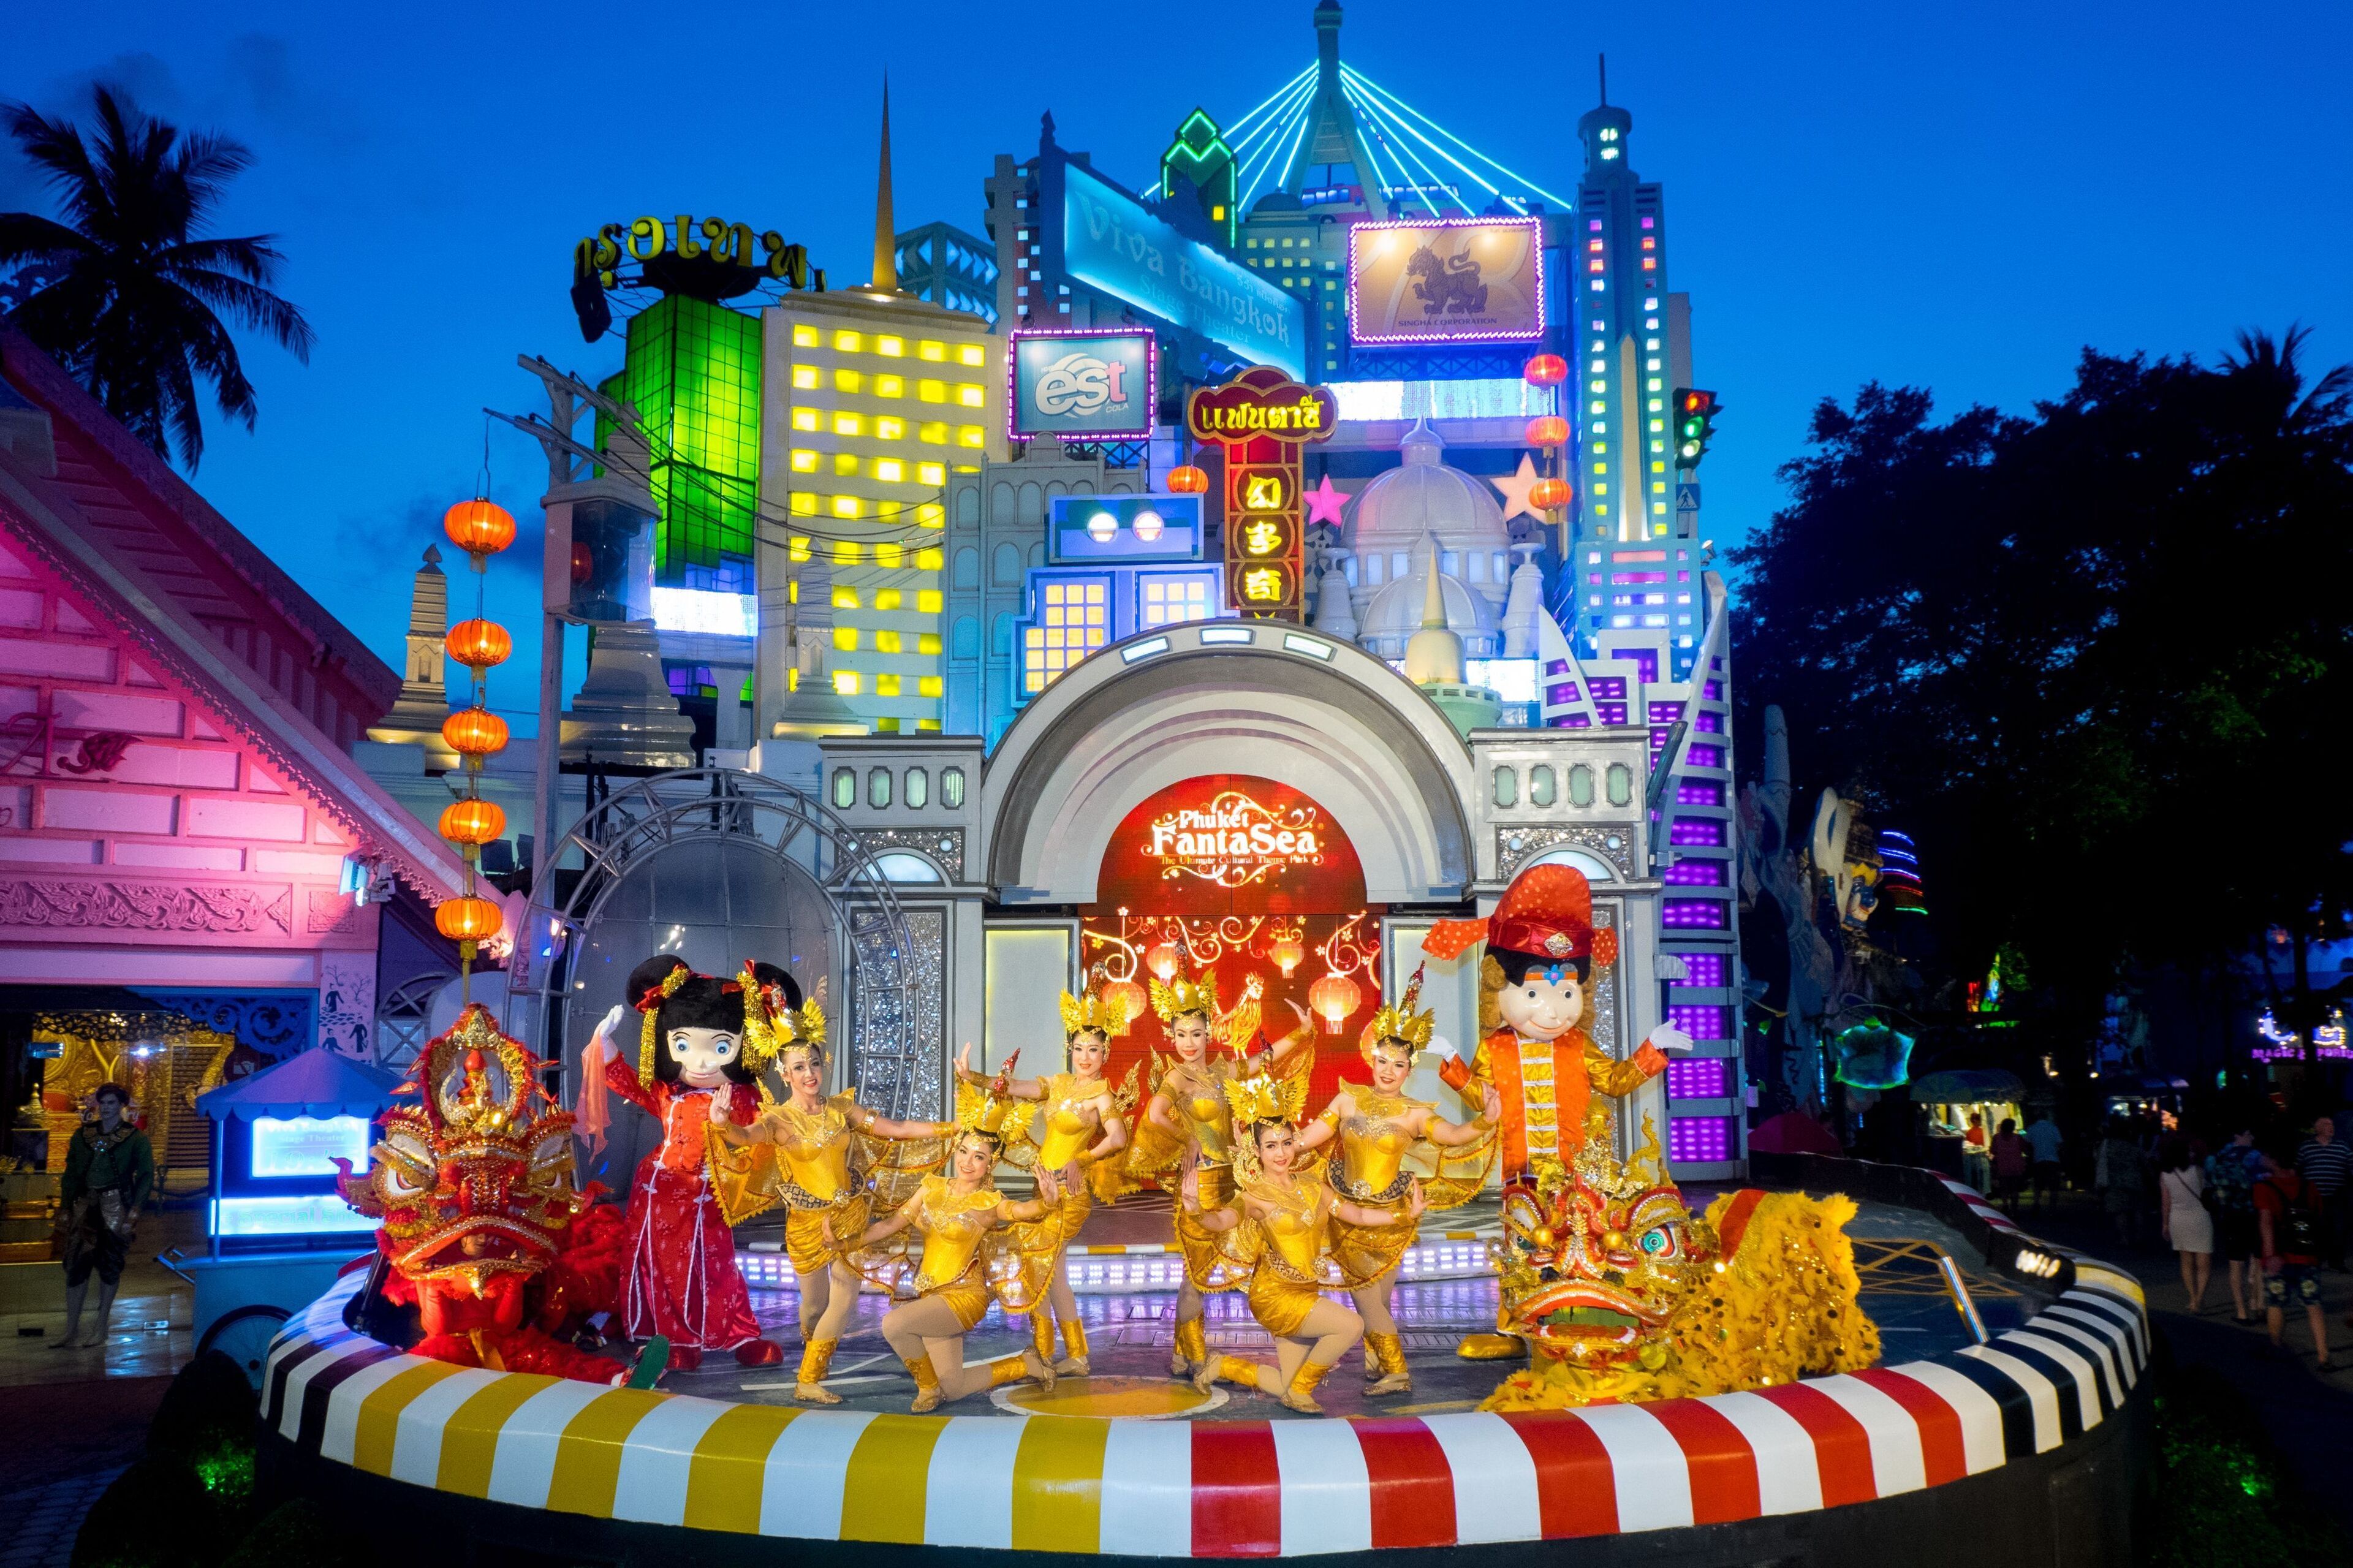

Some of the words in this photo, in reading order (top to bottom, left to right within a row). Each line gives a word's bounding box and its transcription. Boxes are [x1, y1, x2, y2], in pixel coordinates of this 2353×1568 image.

[1076, 191, 1164, 276] Viva
[1175, 251, 1290, 348] Bangkok
[1140, 275, 1184, 314] Stage
[1193, 303, 1251, 344] Theater
[1035, 361, 1127, 415] est
[1106, 404, 1129, 413] COLA
[1202, 394, 1324, 429] แฟนตาซี
[1179, 809, 1249, 828] Phuket
[1151, 823, 1318, 855] FantaSea
[1161, 855, 1175, 865] The
[1180, 855, 1216, 865] Ultimate
[1219, 855, 1253, 865] Cultural
[1290, 854, 1308, 863] Park
